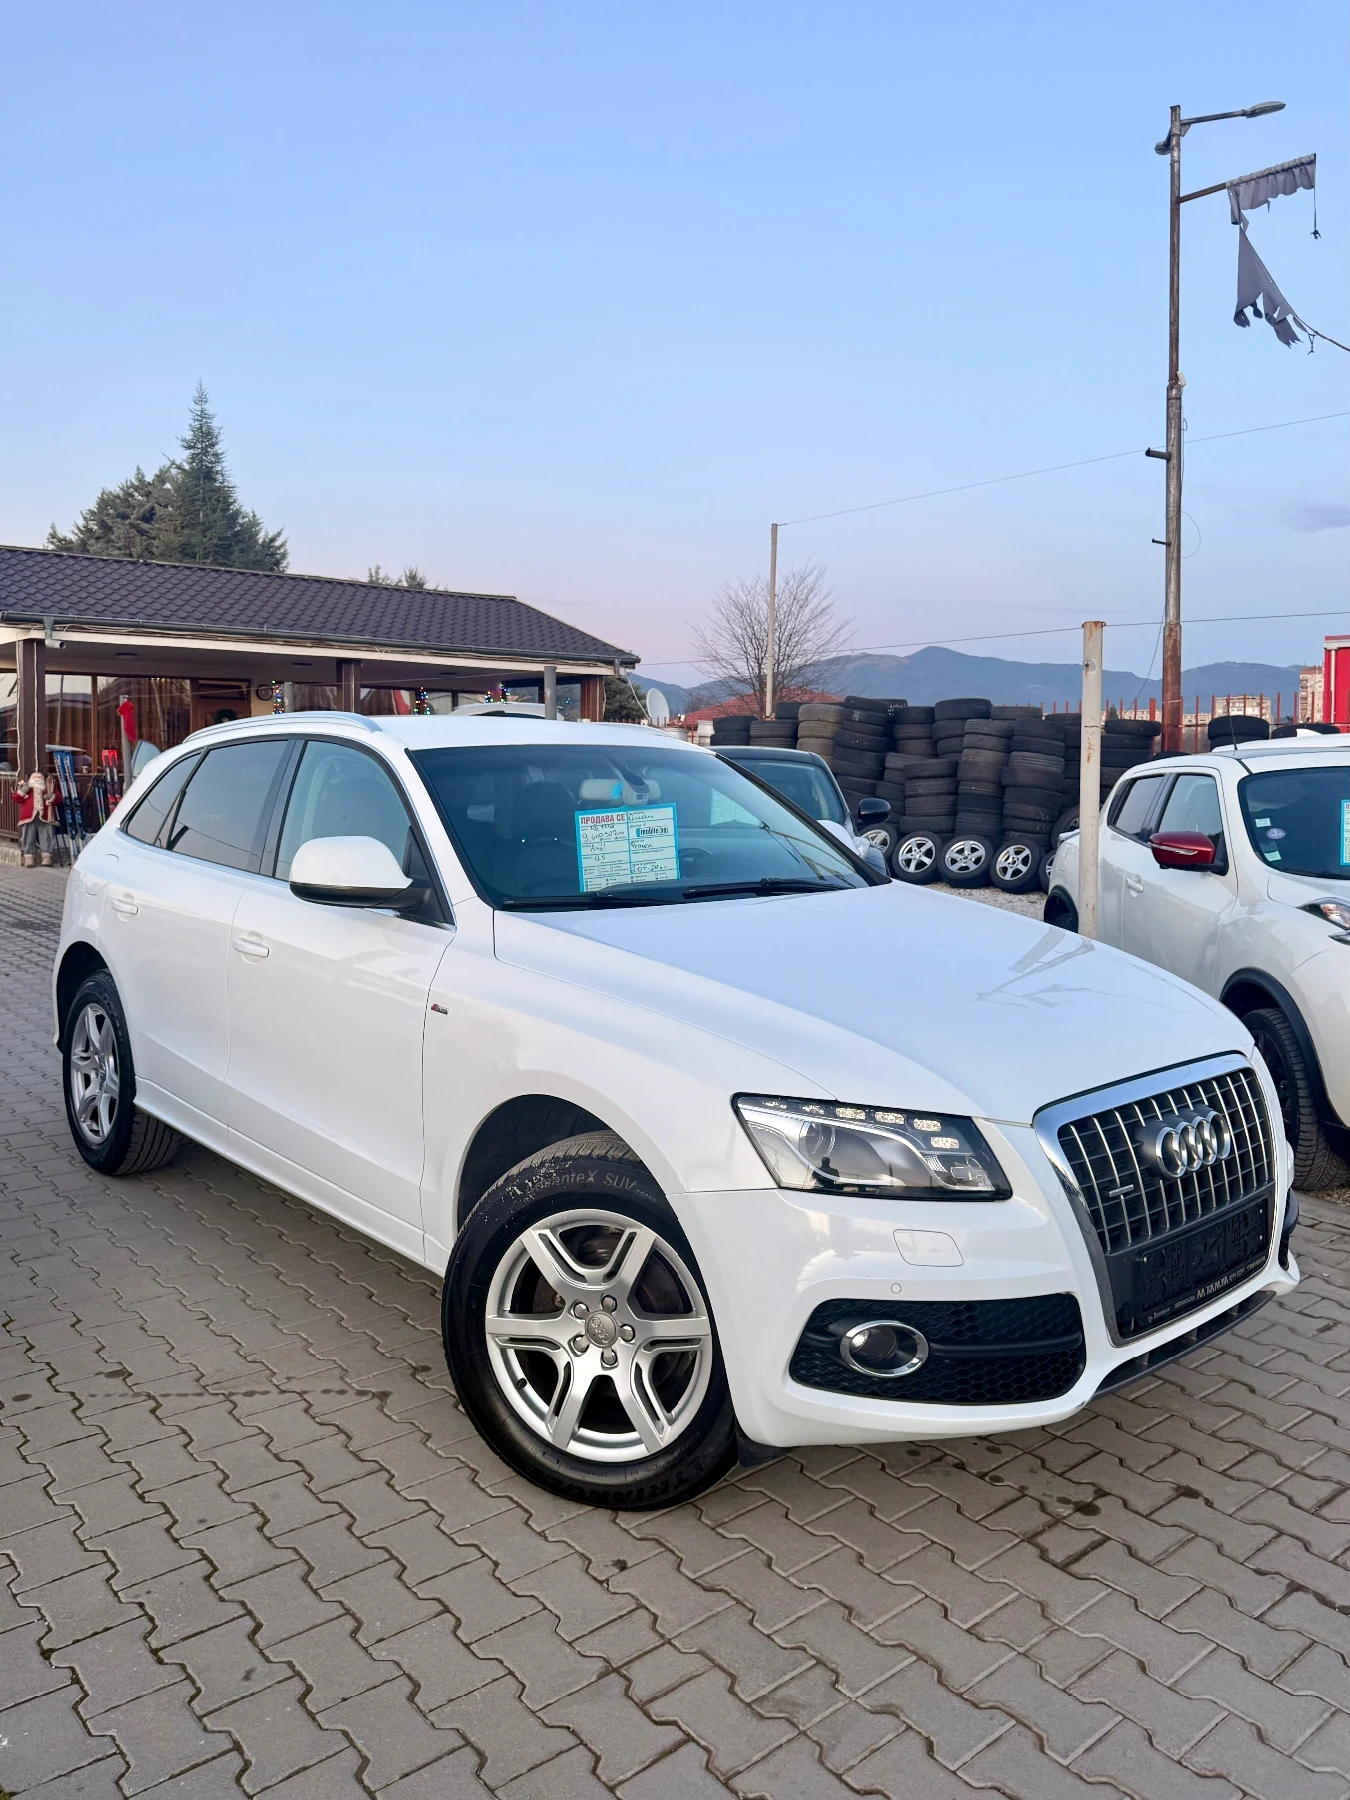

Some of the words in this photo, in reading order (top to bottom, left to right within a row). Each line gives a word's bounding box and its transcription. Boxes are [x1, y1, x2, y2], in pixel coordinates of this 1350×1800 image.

[580, 814, 615, 825] ПРОДАВА
[616, 813, 626, 822] СЕ
[603, 1172, 637, 1190] SUV
